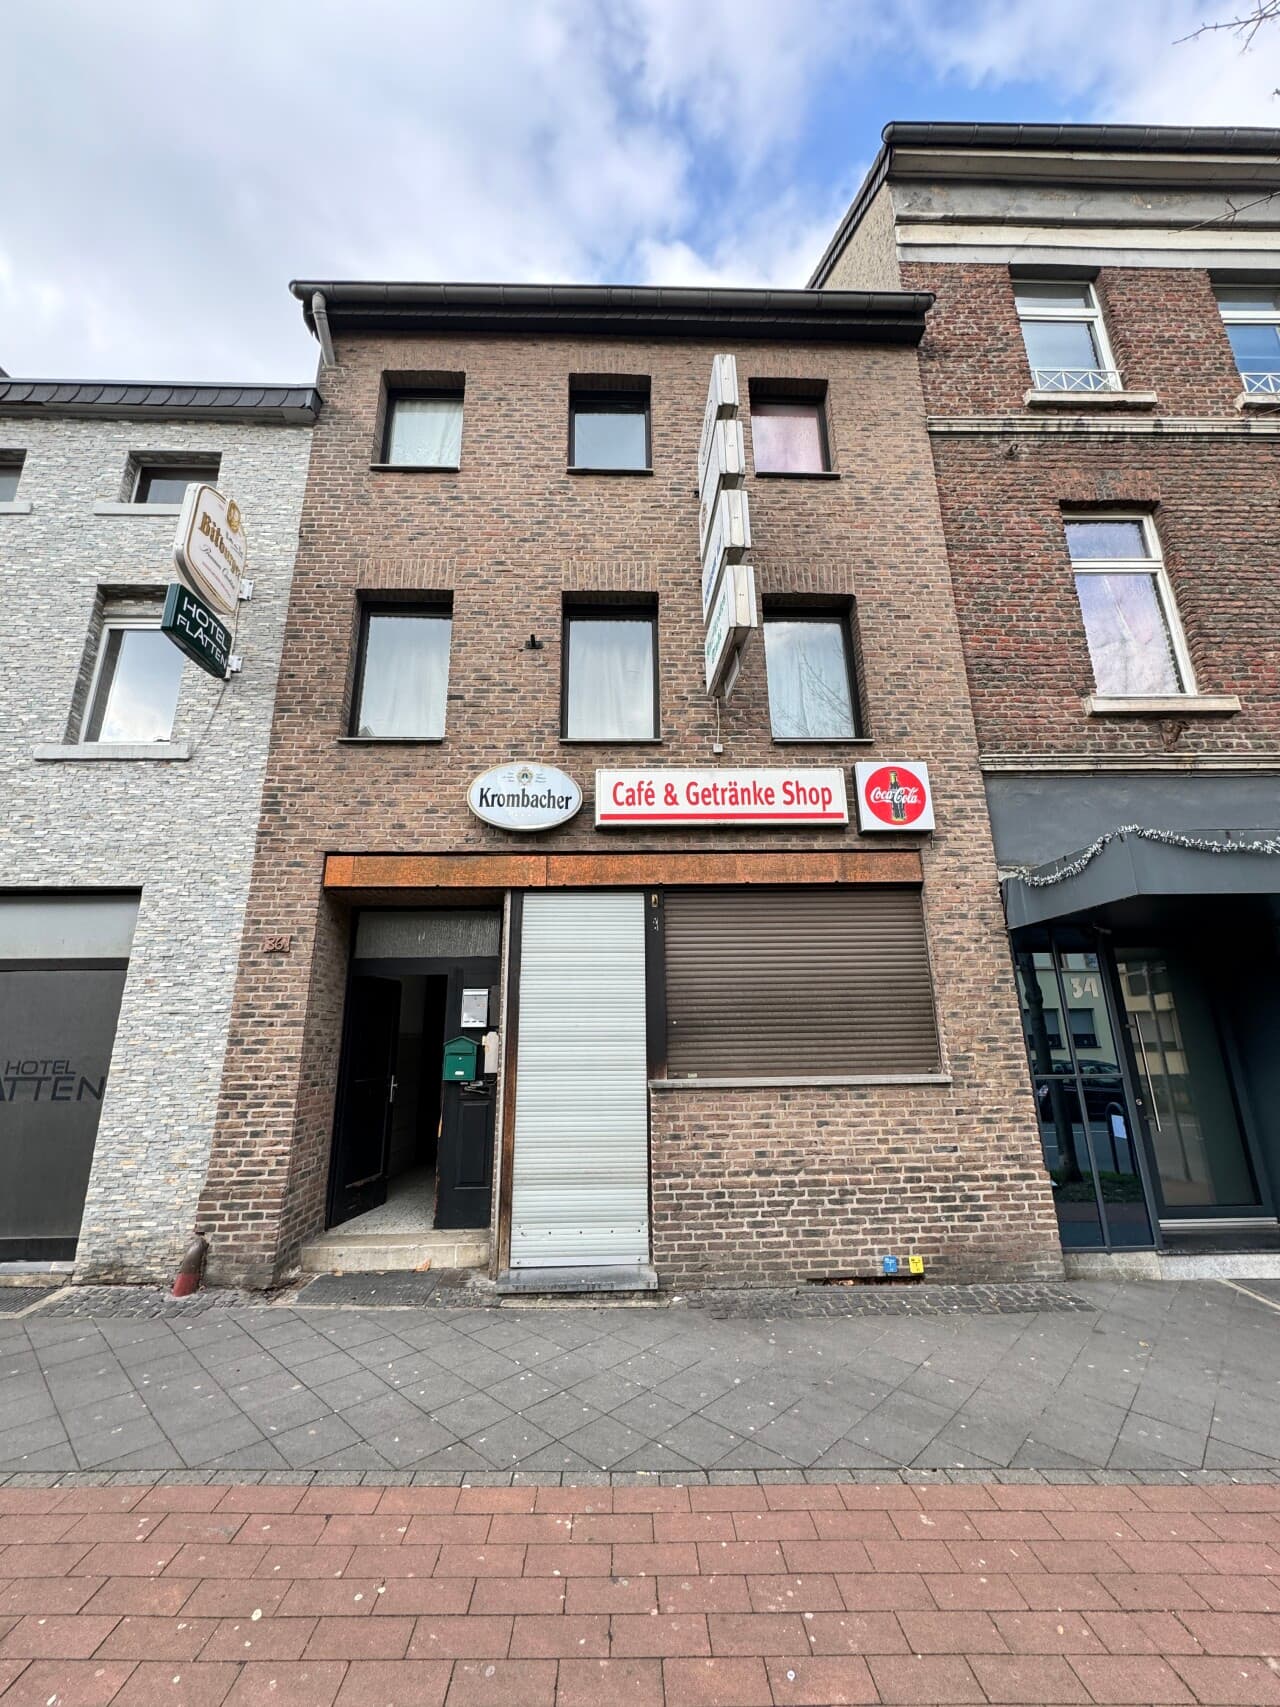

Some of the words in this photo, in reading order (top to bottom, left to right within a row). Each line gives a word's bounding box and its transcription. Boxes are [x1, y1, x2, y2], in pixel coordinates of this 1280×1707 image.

[183, 596, 228, 652] HOTEL
[176, 613, 227, 669] FLATTEN
[479, 787, 572, 810] Krombacher
[613, 780, 656, 807] Café
[664, 782, 680, 807] &
[686, 780, 775, 807] Getränke
[782, 780, 832, 811] Shop
[870, 786, 919, 804] Coca-Cola
[265, 936, 285, 951] 36
[1071, 977, 1098, 998] 34
[5, 1060, 76, 1075] HOTEL
